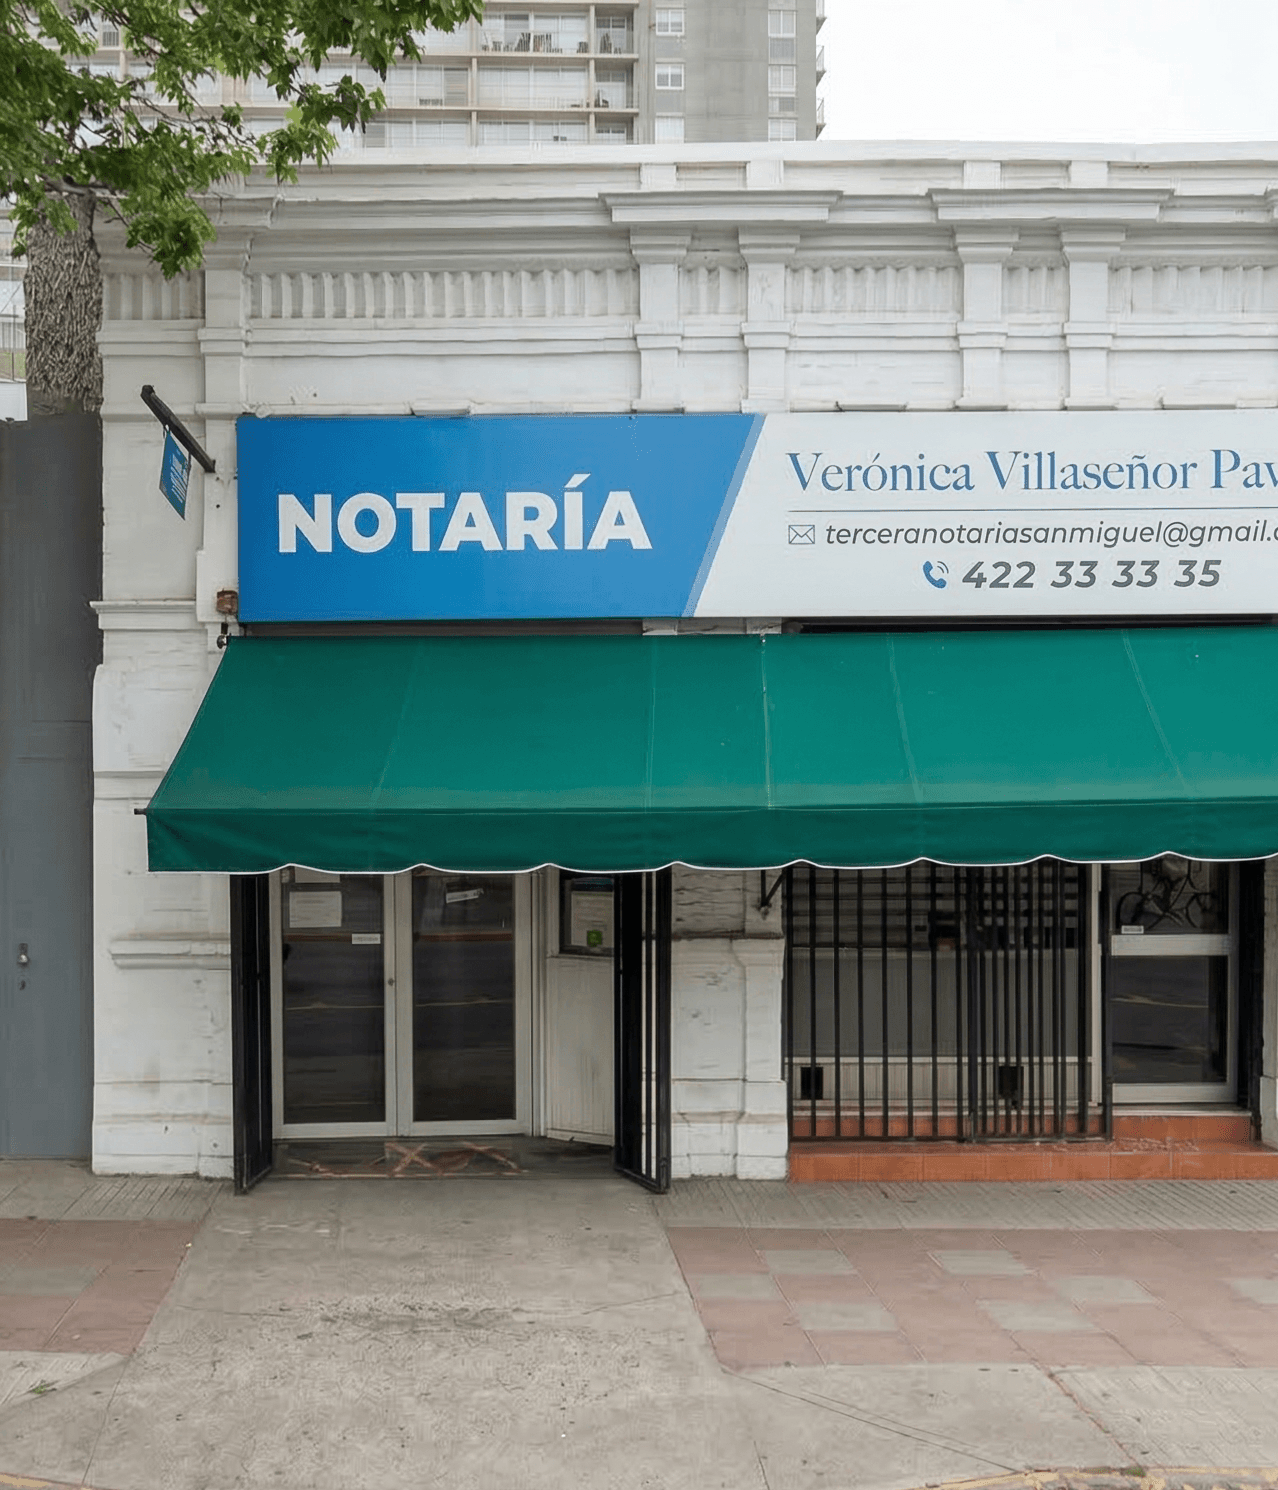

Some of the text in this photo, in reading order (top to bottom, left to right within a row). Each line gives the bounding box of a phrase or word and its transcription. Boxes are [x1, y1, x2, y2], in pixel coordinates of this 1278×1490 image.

[786, 452, 976, 492] Verónica
[985, 450, 1198, 490] Villaseñor
[278, 473, 653, 553] NOTARÍA
[961, 559, 1222, 589] 422 33 33 35
